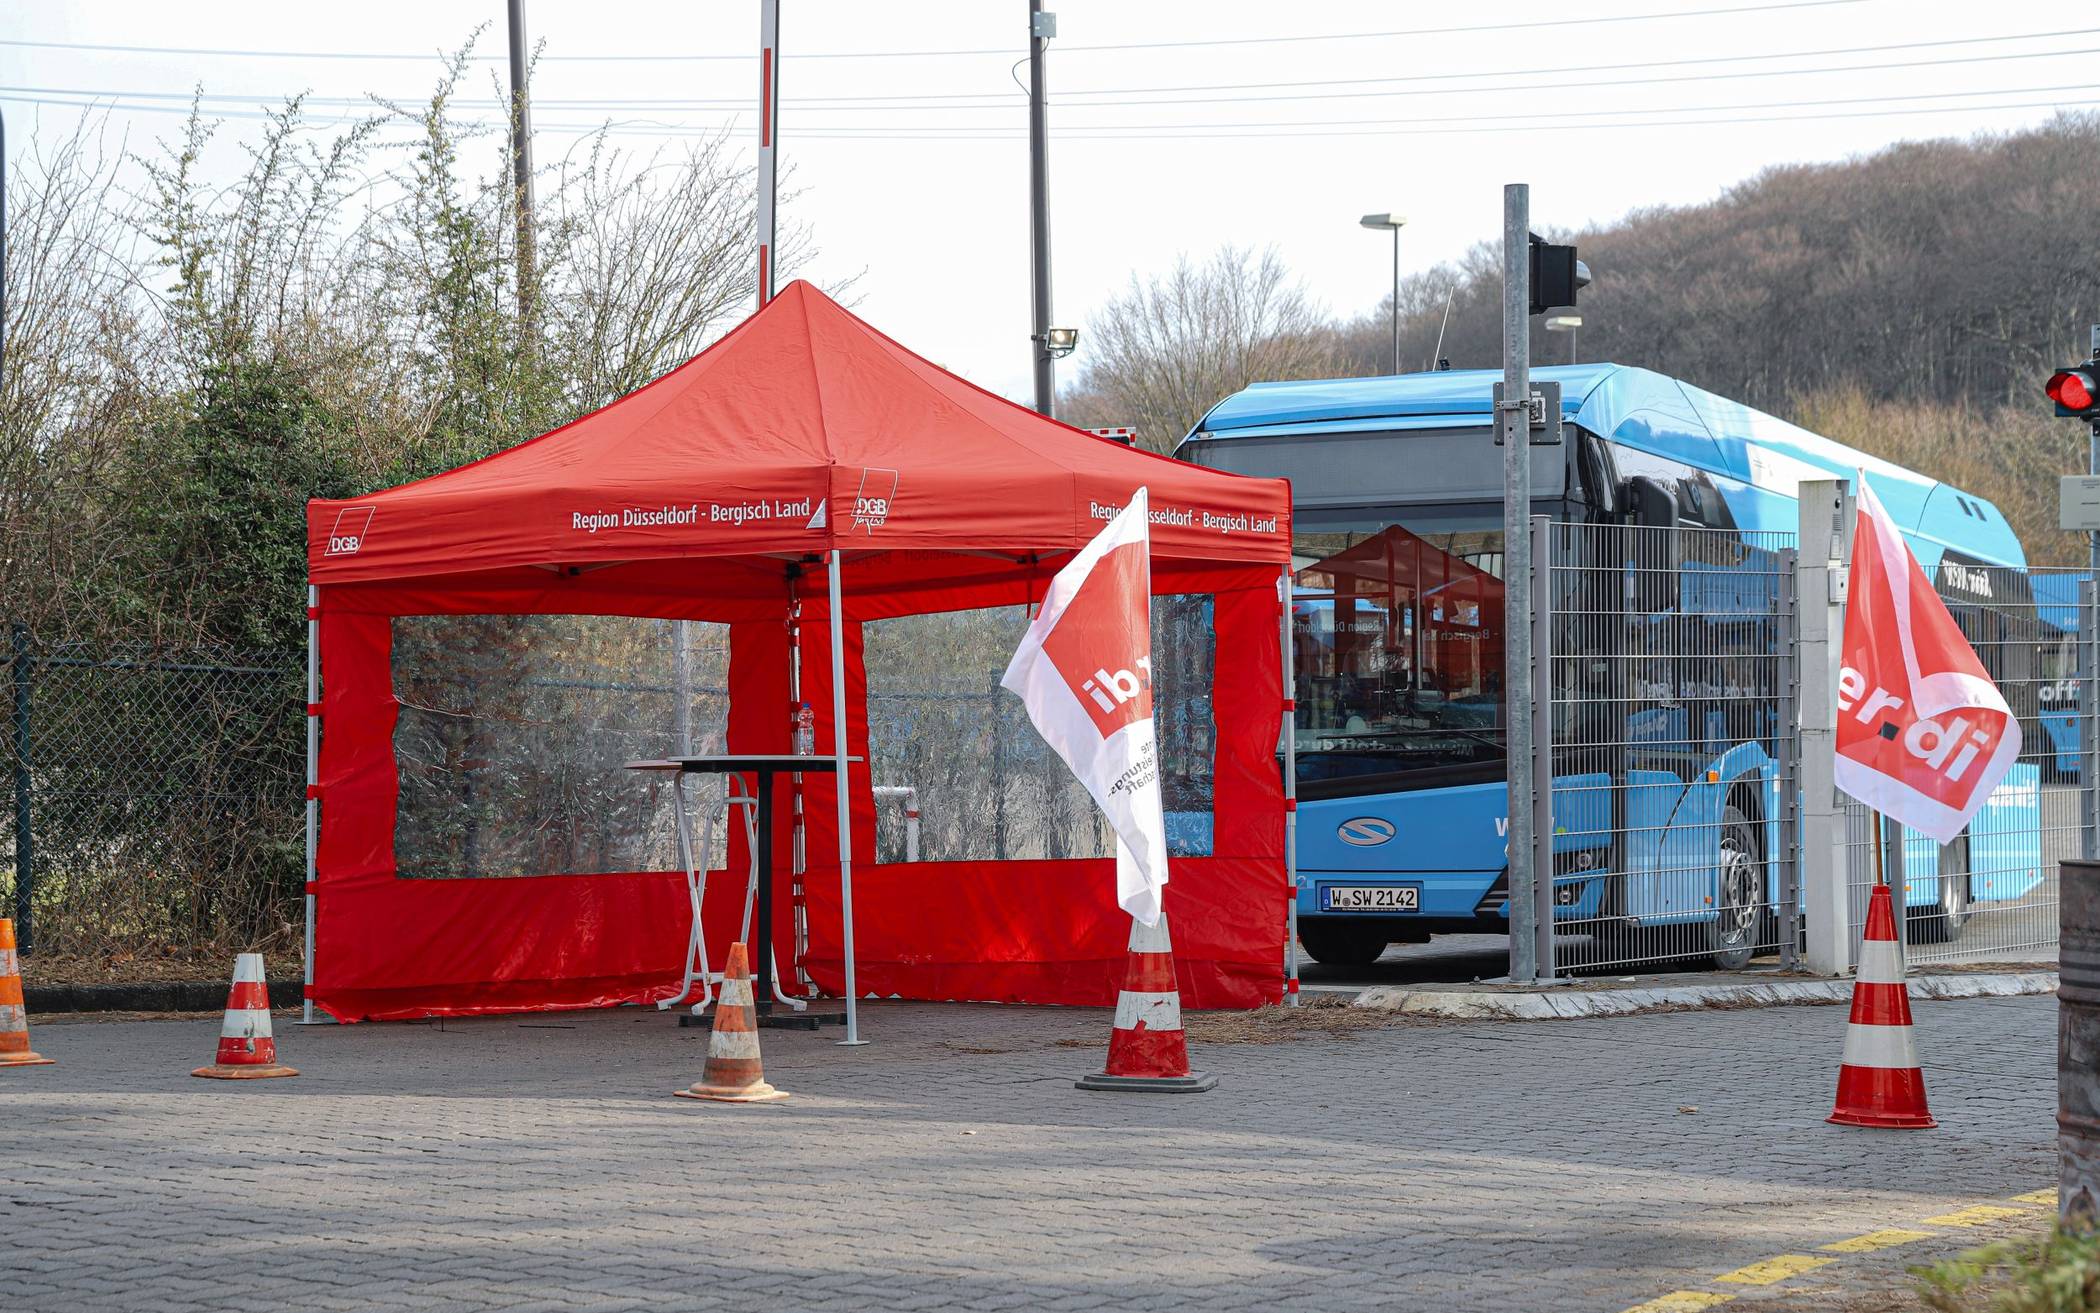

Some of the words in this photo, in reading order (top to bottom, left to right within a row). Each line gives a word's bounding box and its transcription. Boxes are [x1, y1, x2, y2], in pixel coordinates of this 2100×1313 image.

[572, 511, 619, 533] Region
[623, 504, 698, 527] Düsseldorf
[711, 499, 771, 526] Bergisch
[775, 497, 810, 518] Land
[857, 498, 886, 515] DGB
[1090, 501, 1123, 524] Regio
[1148, 507, 1193, 527] sseldorf
[1202, 511, 1248, 534] Bergisch
[1251, 513, 1277, 533] Land
[331, 536, 359, 552] DGB
[1838, 666, 1990, 782] er.di
[1331, 889, 1342, 906] W
[1352, 889, 1373, 906] SW
[1376, 889, 1416, 906] 2142
